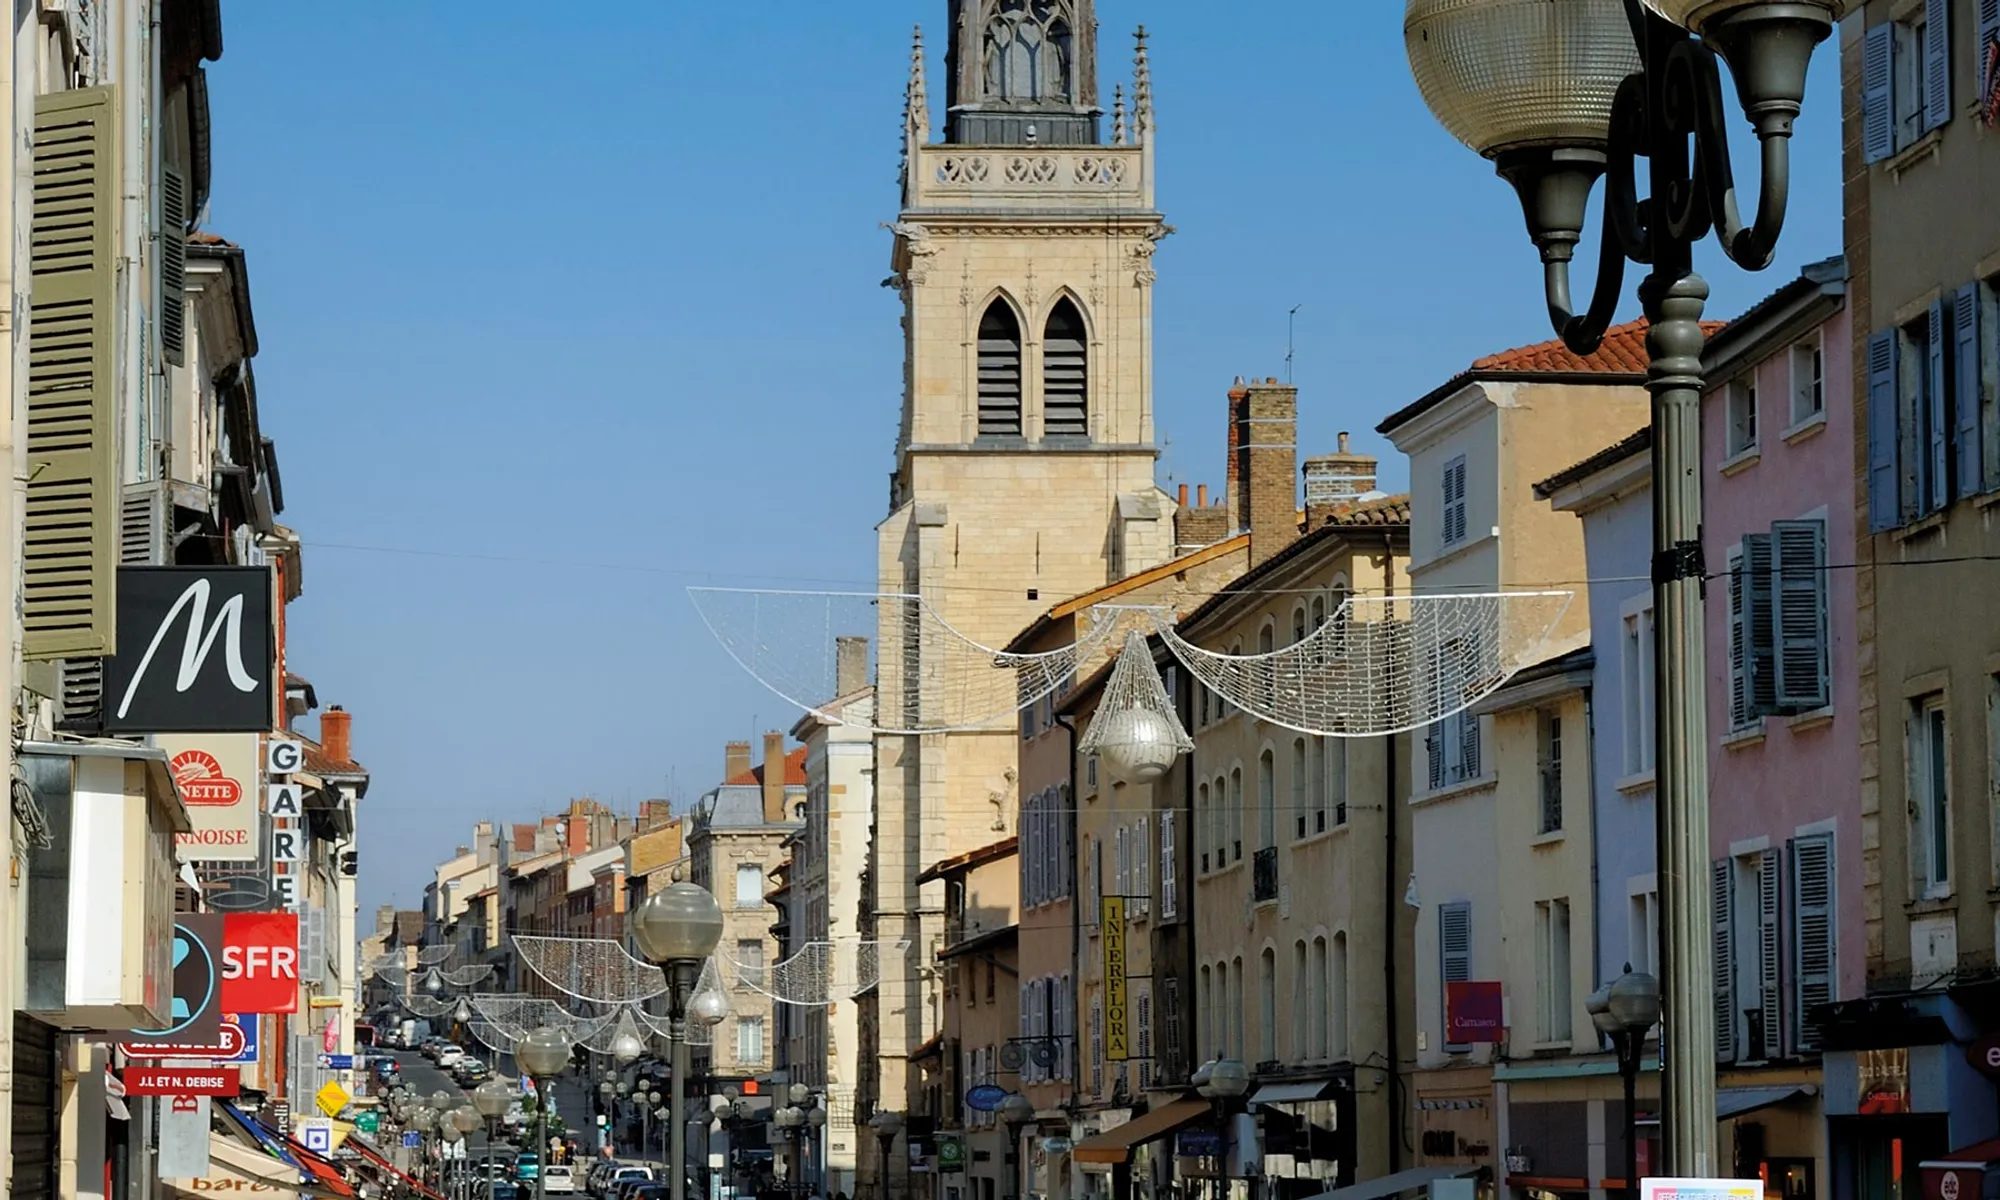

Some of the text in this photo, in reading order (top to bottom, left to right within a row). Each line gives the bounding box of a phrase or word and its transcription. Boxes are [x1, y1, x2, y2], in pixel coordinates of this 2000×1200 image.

[222, 945, 296, 980] SFR
[1106, 906, 1125, 1050] INTERFLORA
[157, 1076, 170, 1088] ET
[172, 1076, 184, 1088] N.
[185, 1076, 225, 1088] DEBISE
